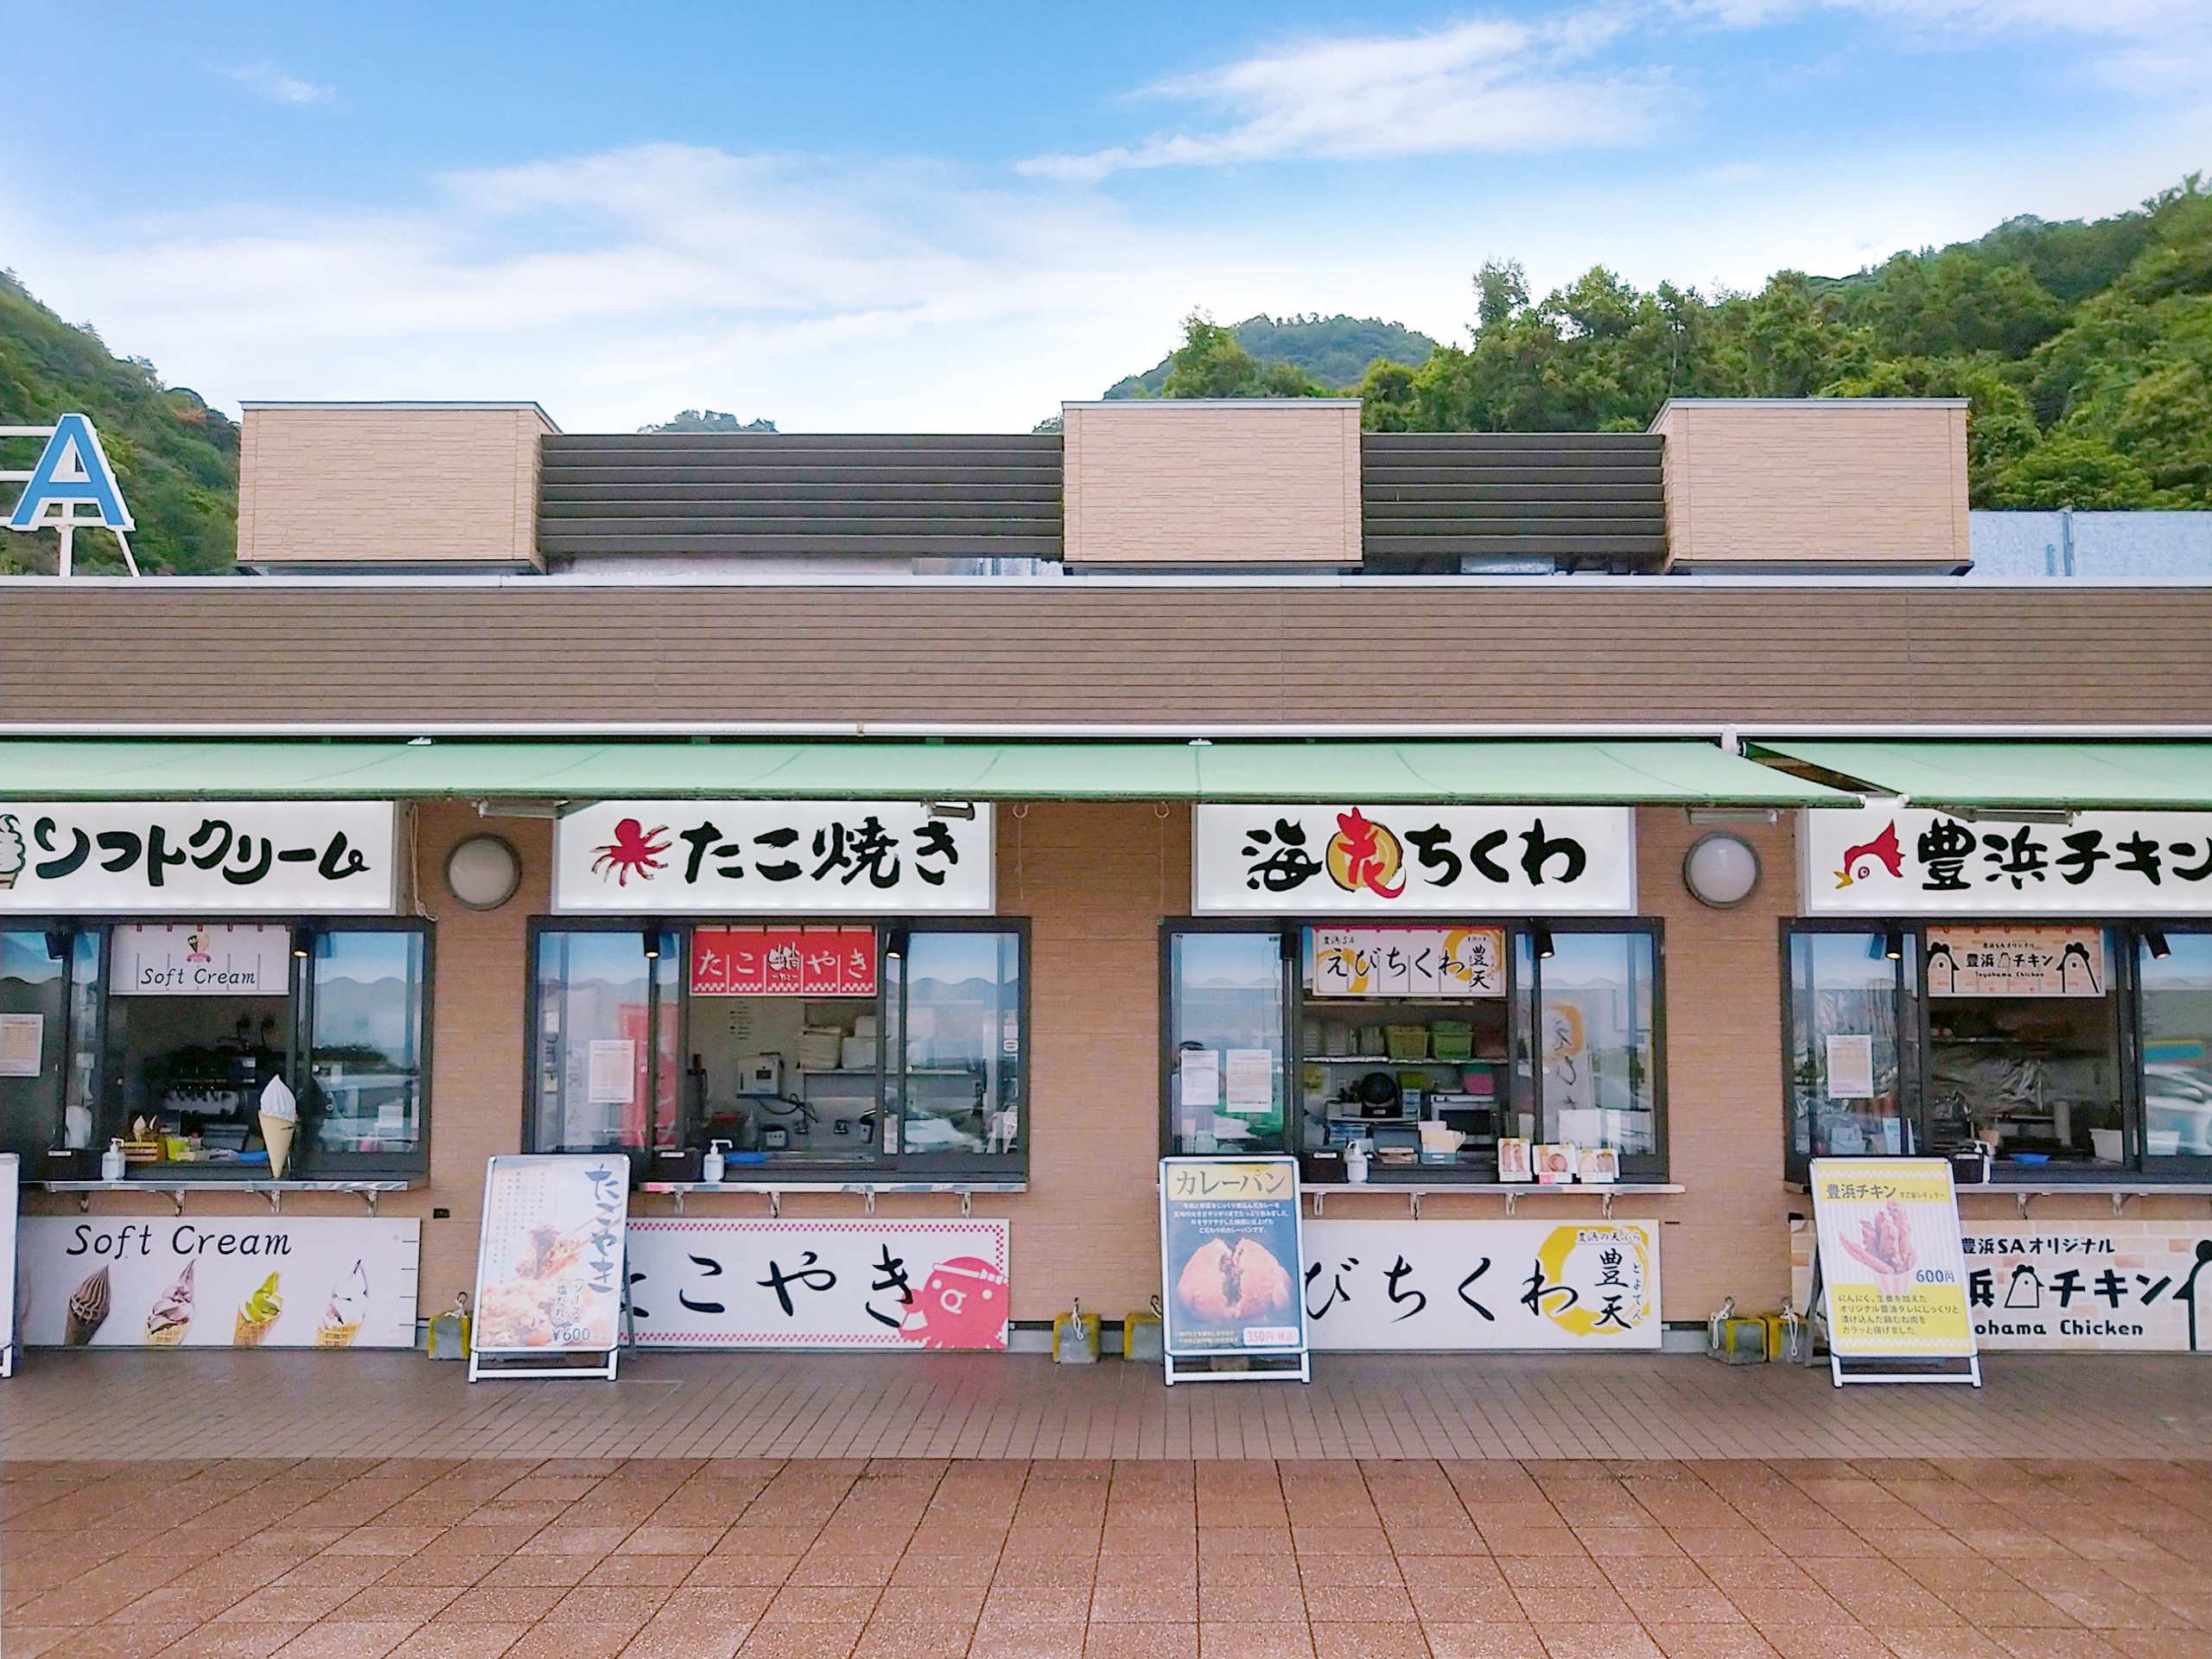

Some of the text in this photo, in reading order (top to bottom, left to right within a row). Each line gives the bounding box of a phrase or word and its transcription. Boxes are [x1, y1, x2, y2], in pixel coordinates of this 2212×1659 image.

[8, 413, 135, 531] A
[34, 816, 372, 887] ソフトクリーム
[679, 817, 959, 888] たこ焼き
[1916, 817, 2212, 891] 豊浜チキン
[140, 967, 257, 987] Soft Cream
[1176, 1169, 1287, 1196] カレーパン
[1826, 1183, 1897, 1199] 豊浜チキン
[66, 1224, 292, 1259] Soft Cream
[584, 1163, 620, 1293] たこやき
[1916, 1268, 1955, 1283] 600円
[552, 1327, 591, 1342] ¥600
[2060, 1319, 2144, 1336] Chicken
